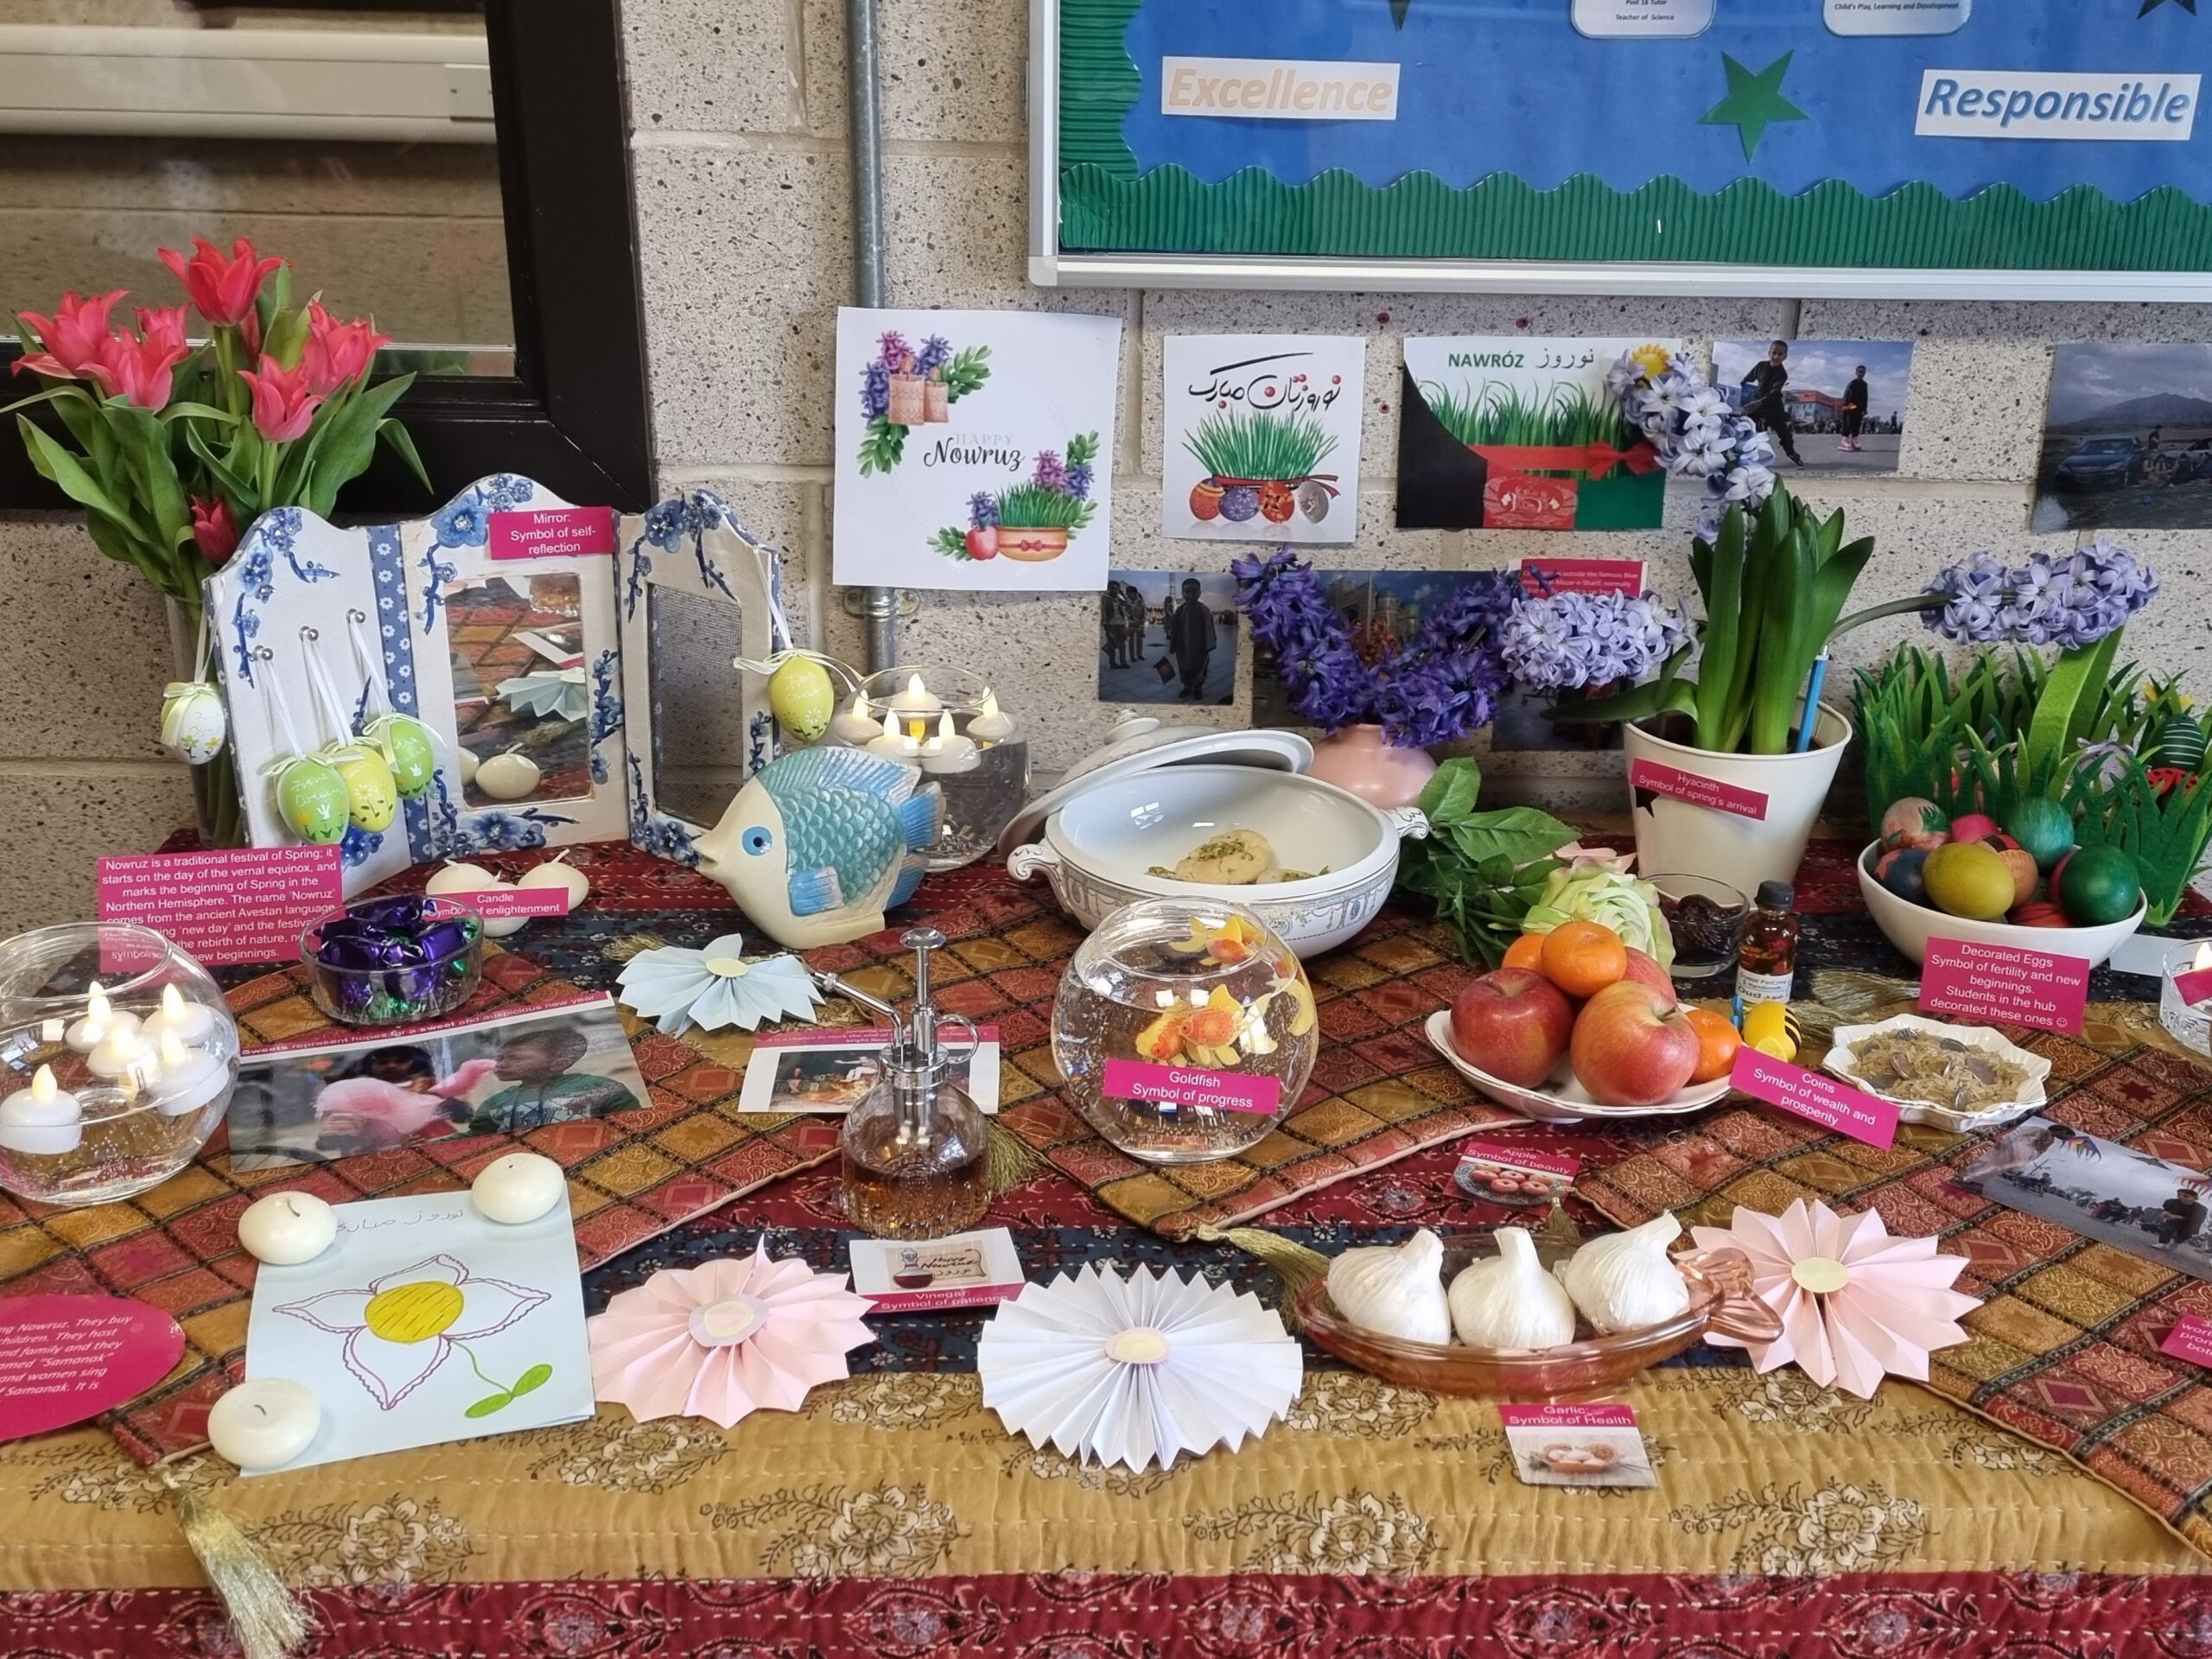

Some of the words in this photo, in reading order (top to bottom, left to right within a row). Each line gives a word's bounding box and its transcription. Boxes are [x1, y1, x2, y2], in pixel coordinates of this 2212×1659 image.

[1873, 3, 1901, 11] Learning
[1167, 67, 1393, 112] Excellence
[1924, 78, 2191, 127] Responsible
[1448, 349, 1525, 369] NAWRÓZ
[1535, 346, 1595, 370] نوروز
[952, 433, 1014, 447] HAPPY
[924, 436, 1026, 473] Nowruz
[533, 512, 571, 524] Mirror:
[511, 529, 554, 543] Symbol
[557, 527, 569, 538] of
[571, 525, 596, 537] self-
[529, 543, 581, 555] reflection
[1677, 773, 1720, 793] Hyacinth
[1639, 775, 1674, 791] Symbol
[1675, 786, 1686, 795] of
[1687, 790, 1725, 806] spring's
[1726, 800, 1758, 815] arrival
[105, 861, 149, 870] Nowruz
[151, 859, 160, 868] is
[174, 854, 227, 867] traditional
[231, 852, 269, 862] festival
[271, 850, 283, 861] of
[326, 848, 333, 857] it
[102, 874, 133, 885] starts
[154, 872, 171, 881] the
[174, 871, 194, 881] day
[197, 868, 208, 880] of
[211, 868, 228, 878] the
[231, 866, 264, 877] vernal
[267, 864, 313, 875] equinox,
[316, 861, 337, 872] and
[123, 887, 156, 897] marks
[160, 885, 177, 895] the
[180, 881, 233, 895] beginning
[237, 879, 247, 890] of
[251, 879, 285, 890] Spring
[289, 877, 298, 887] in
[302, 876, 319, 887] the
[105, 899, 155, 912] Northern
[158, 898, 228, 909] Hemisphere.
[231, 893, 252, 905] The
[255, 893, 286, 903] name
[477, 893, 515, 904] Candle
[147, 913, 172, 923] from
[175, 912, 193, 921] the
[195, 909, 236, 920] ancient
[238, 907, 282, 918] Avestan
[284, 904, 335, 916] language
[486, 904, 560, 916] enlightenment
[234, 921, 254, 932] and
[257, 920, 274, 930] the
[177, 939, 194, 950] the
[197, 936, 232, 948] rebirth
[236, 934, 247, 944] of
[216, 948, 280, 962] beginnings.
[1961, 944, 2020, 963] Decorated
[2024, 953, 2054, 969] Eggs
[1931, 955, 1974, 969] Symbol
[1976, 961, 1989, 972] of
[1990, 963, 2028, 980] fertility
[2031, 971, 2053, 983] and
[2056, 975, 2081, 987] new
[1969, 975, 2035, 995] beginnings.
[1946, 985, 1997, 1002] Students
[1999, 993, 2010, 1004] in
[2012, 995, 2031, 1008] the
[2033, 1000, 2056, 1013] hub
[1930, 997, 1987, 1015] decorated
[1990, 1005, 2022, 1020] these
[2024, 1014, 2054, 1027] ones
[242, 1045, 289, 1055] Sweets
[291, 1038, 348, 1050] represent
[351, 1033, 387, 1043] hopes
[420, 1021, 455, 1032] sweet
[458, 1016, 480, 1027] and
[482, 1005, 543, 1021] auspicious
[545, 1000, 568, 1008] new
[570, 995, 596, 1005] year
[1169, 1071, 1221, 1089] Goldfish
[1802, 1073, 1835, 1094] Coins
[1133, 1083, 1180, 1100] Symbol
[1183, 1089, 1197, 1102] of
[1198, 1093, 1254, 1109] progress
[1753, 1068, 1797, 1093] Symbol
[1798, 1088, 1813, 1098] of
[1813, 1093, 1851, 1116] wealth
[1853, 1109, 1876, 1125] and
[1781, 1096, 1840, 1127] prosperity
[1467, 1148, 1513, 1163] Symbol
[1529, 1161, 1572, 1175] beauty
[1502, 1148, 1541, 1161] Apple:
[915, 1290, 971, 1300] Vinegar:
[880, 1299, 931, 1311] Symbol
[75, 1317, 108, 1328] They
[108, 1314, 134, 1325] buy
[55, 1332, 87, 1342] They
[88, 1328, 118, 1338] host
[17, 1344, 64, 1358] family
[65, 1342, 92, 1352] and
[93, 1340, 124, 1351] they
[28, 1370, 80, 1382] women
[81, 1367, 108, 1378] sing
[5, 1382, 71, 1396] Samanak.
[75, 1381, 86, 1390] It
[88, 1380, 100, 1390] is
[1543, 1405, 1590, 1415] Garlic:
[1510, 1415, 1563, 1426] Symbol
[1584, 1416, 1632, 1426] Health
